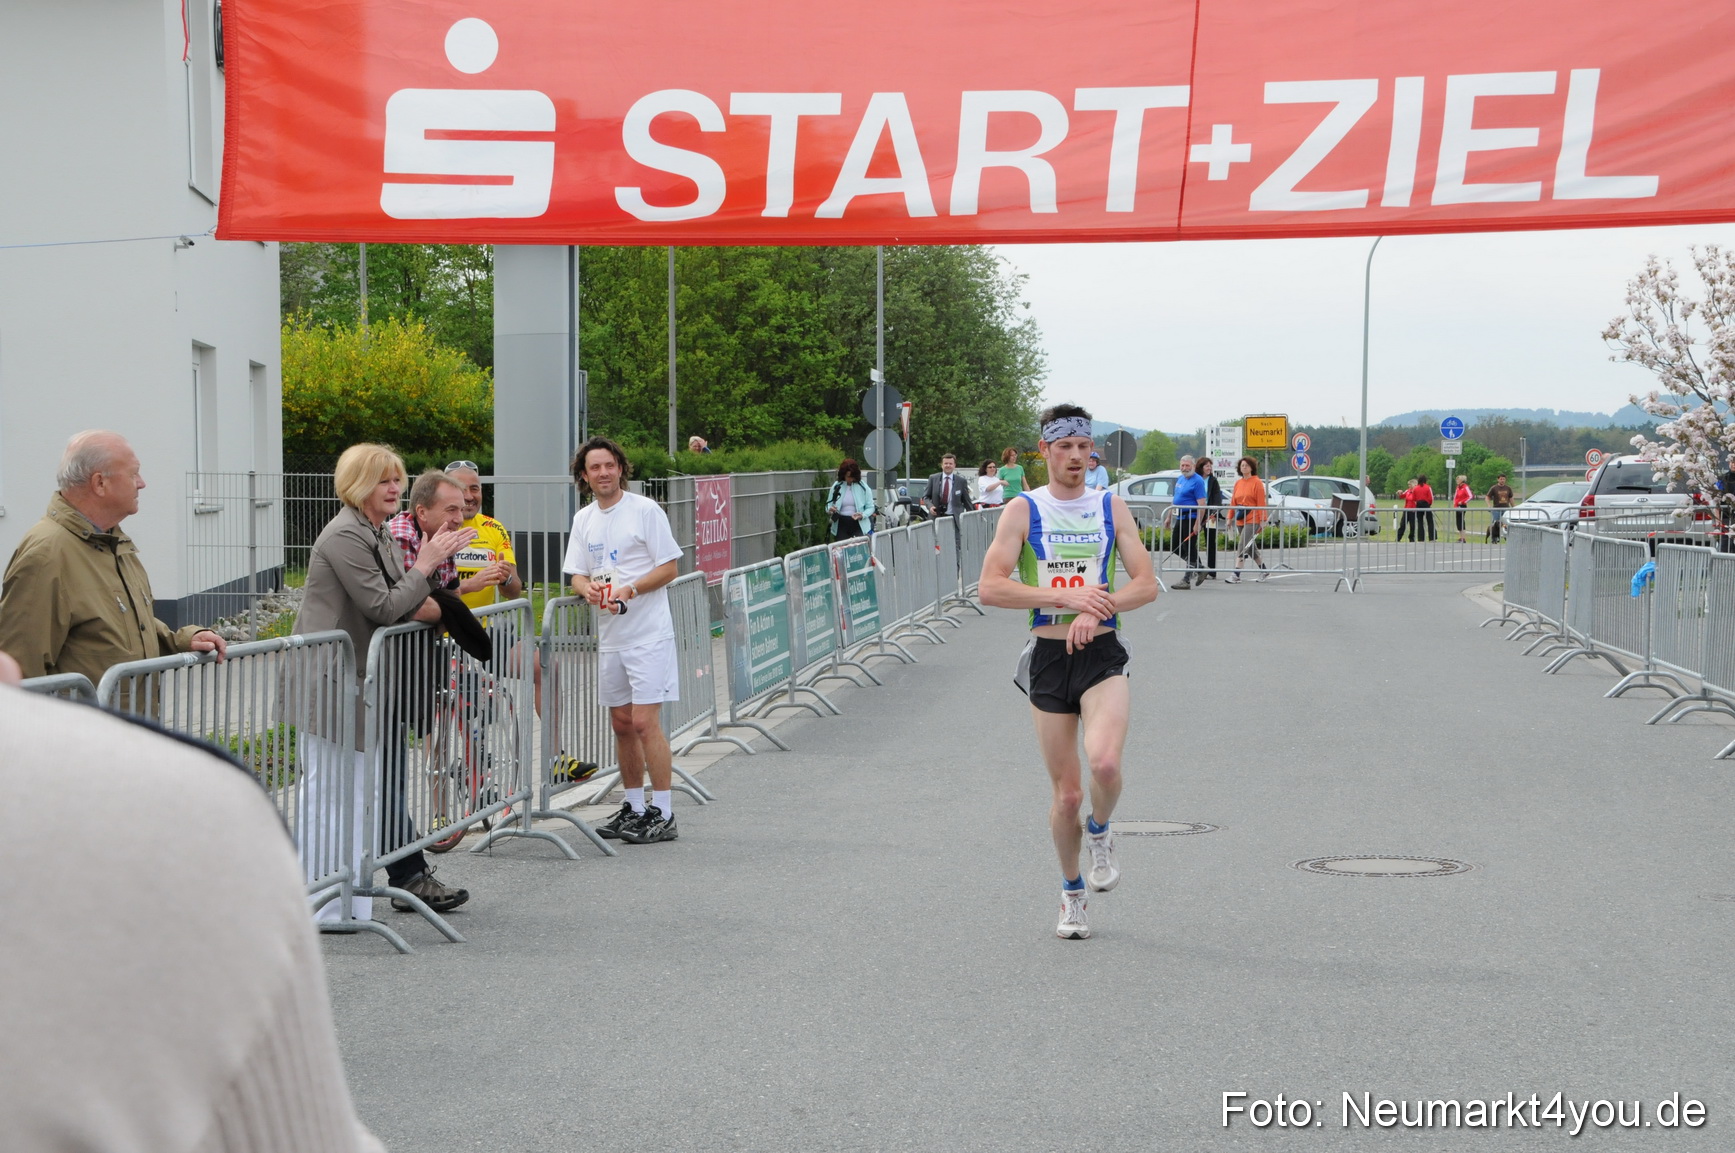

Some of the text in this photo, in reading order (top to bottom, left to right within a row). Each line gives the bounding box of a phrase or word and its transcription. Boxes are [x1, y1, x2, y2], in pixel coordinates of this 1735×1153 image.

[1249, 428, 1283, 436] Neumarkt
[1590, 453, 1599, 463] 60
[701, 517, 728, 546] ZEITLOS
[1048, 532, 1102, 544] BOCK
[1047, 561, 1075, 569] MEYER
